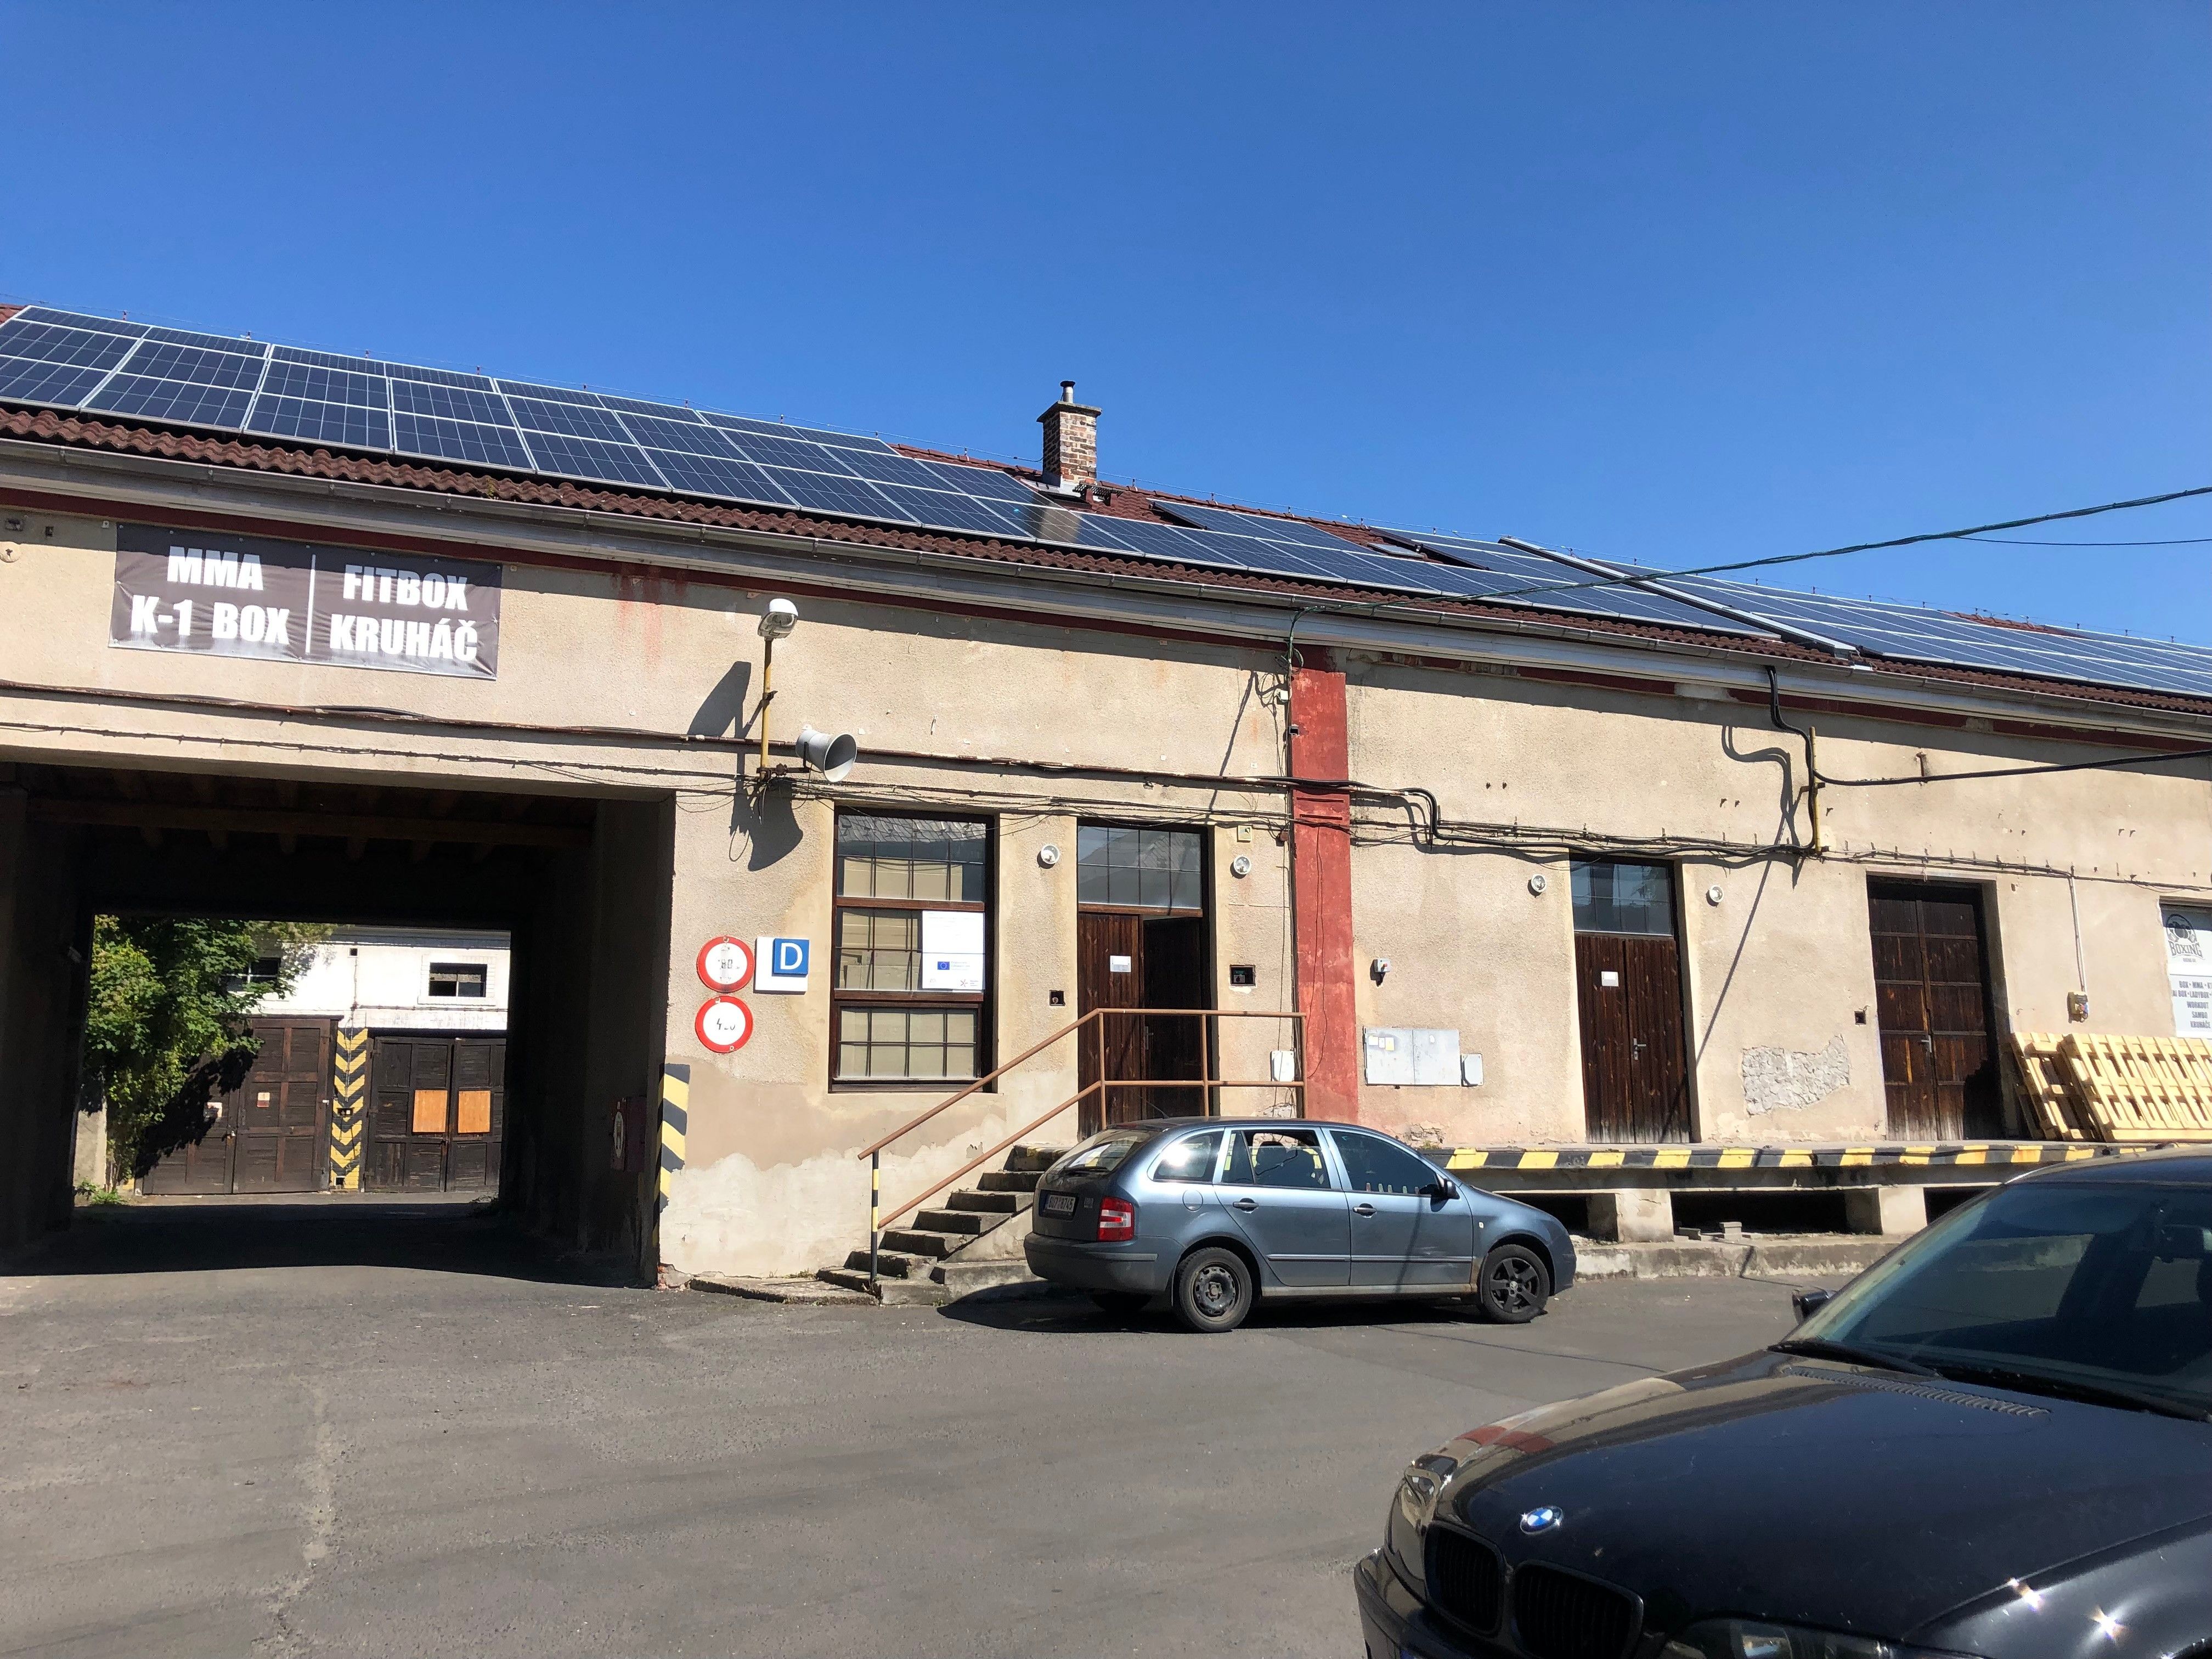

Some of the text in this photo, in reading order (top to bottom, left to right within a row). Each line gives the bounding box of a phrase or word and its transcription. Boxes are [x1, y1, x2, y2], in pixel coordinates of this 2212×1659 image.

[167, 546, 263, 590] MMA
[343, 565, 468, 611] FITBOX
[131, 595, 290, 644] K-1 BOX
[330, 613, 477, 661] KRUHÁČ
[780, 943, 803, 969] D
[2168, 940, 2203, 958] BOXING
